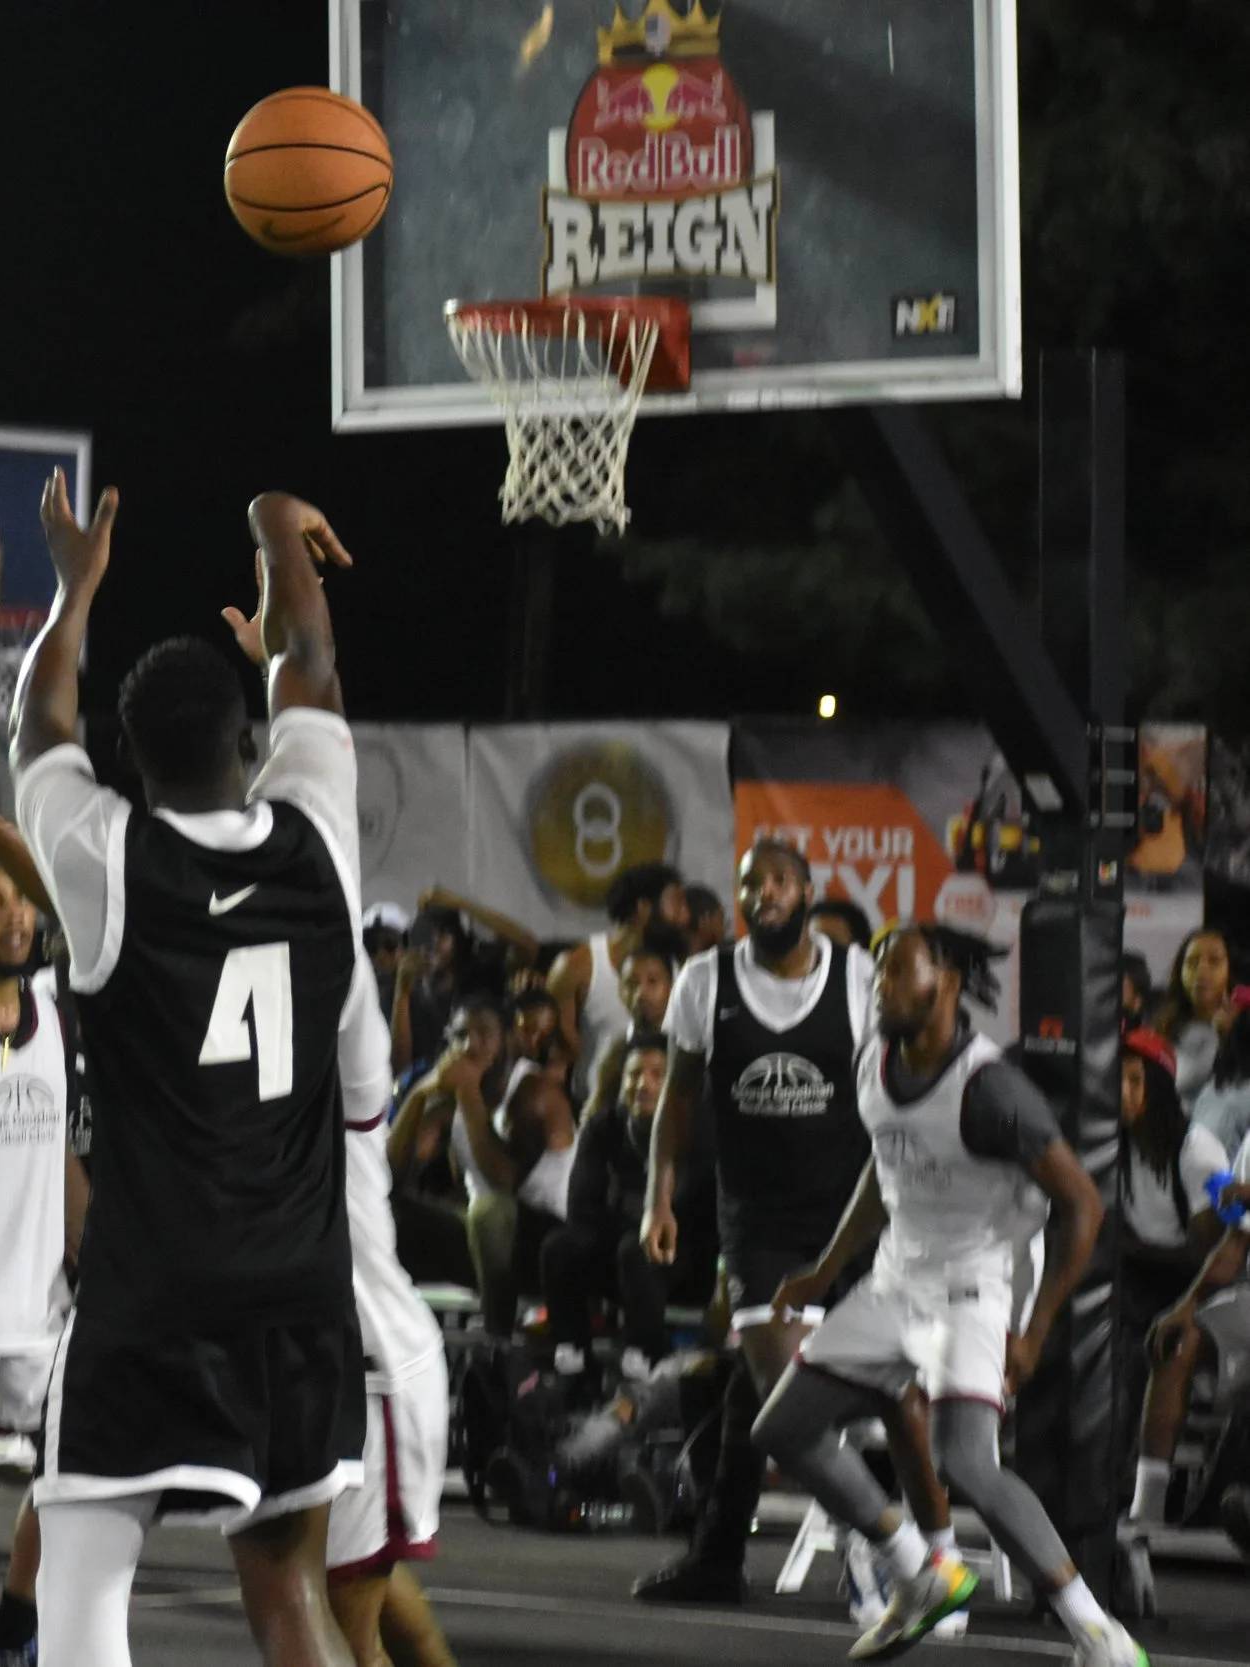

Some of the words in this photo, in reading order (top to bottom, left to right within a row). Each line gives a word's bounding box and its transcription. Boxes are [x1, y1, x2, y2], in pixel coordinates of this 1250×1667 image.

[577, 129, 659, 197] Red
[661, 123, 742, 192] Bull
[546, 178, 775, 295] REIGN
[896, 292, 956, 336] NXT
[822, 825, 915, 861] YOUR
[197, 940, 294, 1102] 4
